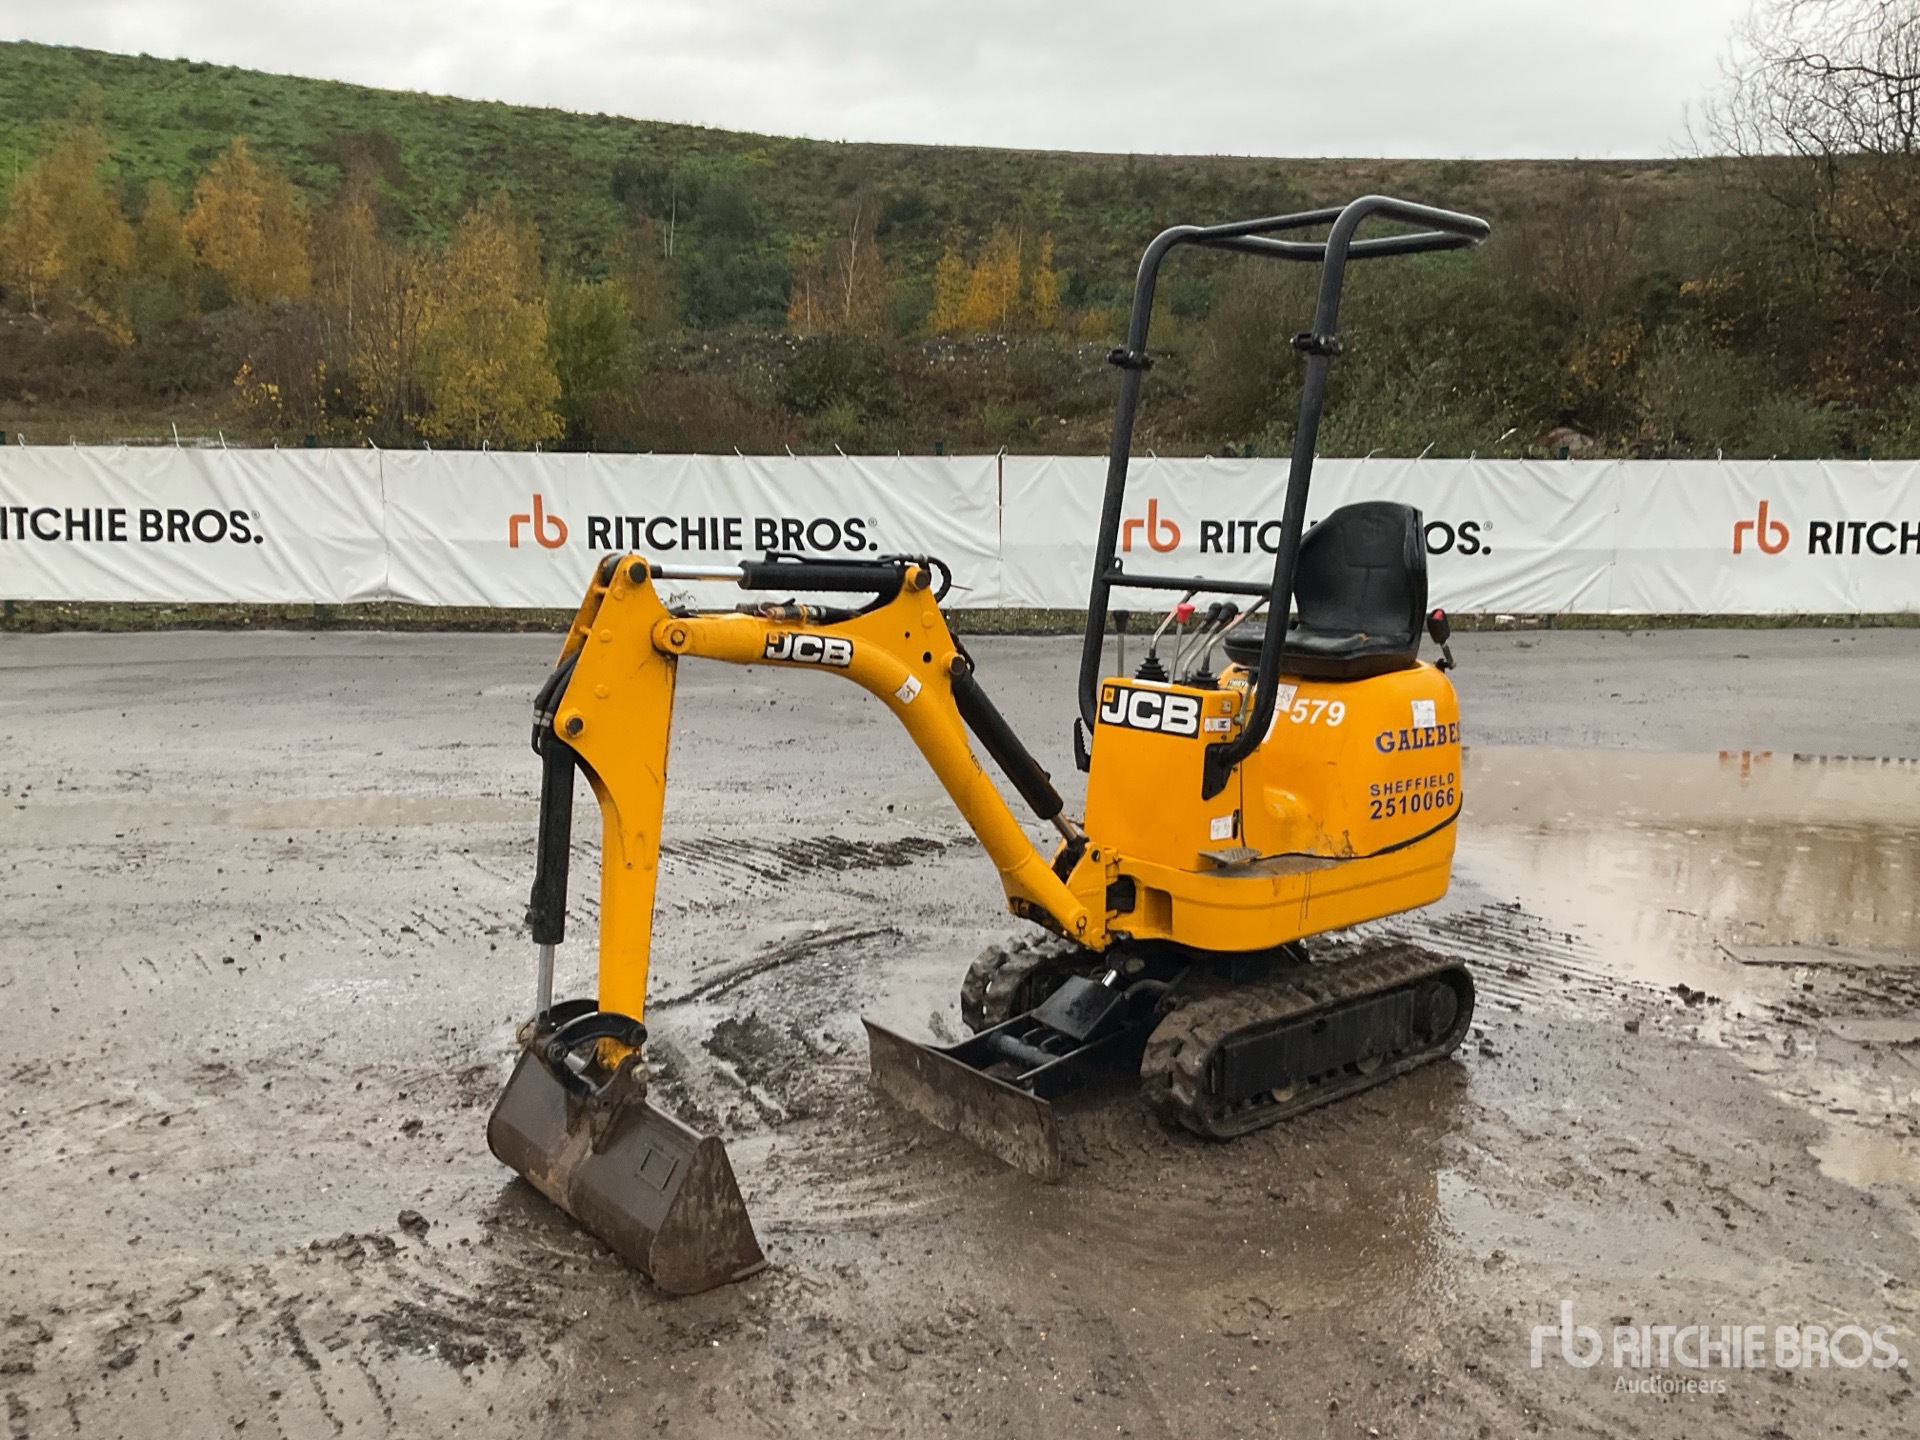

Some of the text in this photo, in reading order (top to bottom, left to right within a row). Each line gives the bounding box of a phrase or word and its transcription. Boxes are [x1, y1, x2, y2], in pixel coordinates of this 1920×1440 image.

[0, 507, 126, 542] ITCHIE
[587, 516, 742, 550] RITCHIE
[1808, 521, 1920, 555] RITCH
[766, 634, 852, 667] JCB
[1101, 689, 1199, 735] JCB
[1369, 772, 1454, 797] SHEFFIELD
[1369, 787, 1454, 819] 2510066
